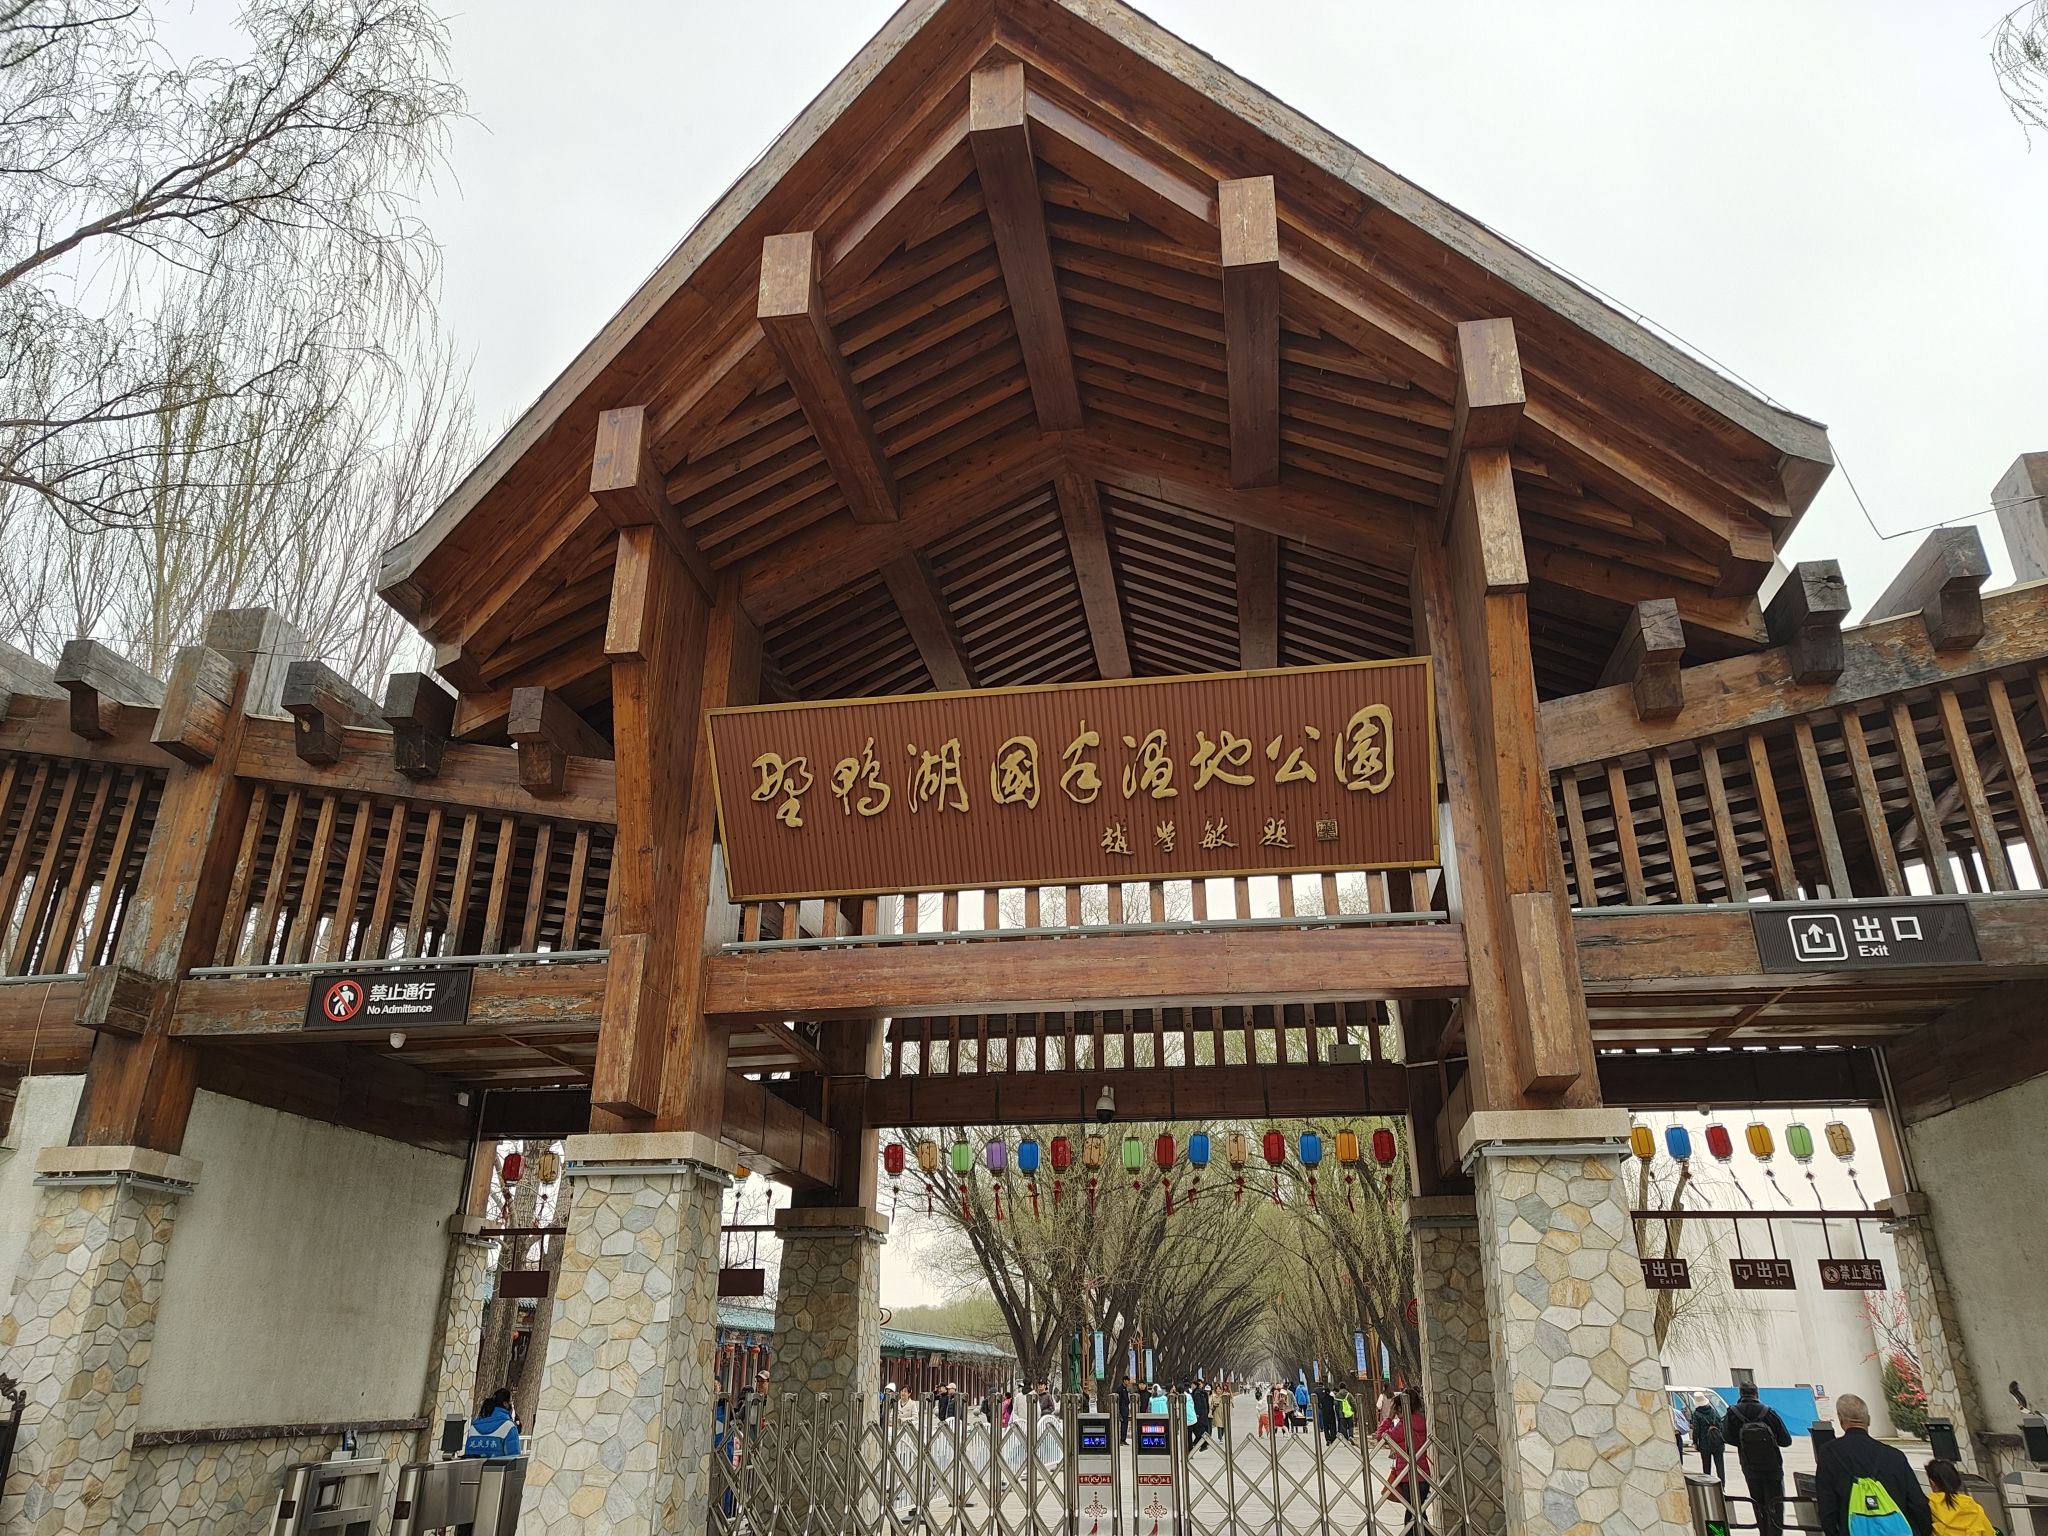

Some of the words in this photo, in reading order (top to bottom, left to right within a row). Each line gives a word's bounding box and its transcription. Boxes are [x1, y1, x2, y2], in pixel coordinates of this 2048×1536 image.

[1852, 915, 1923, 942] 出口
[1858, 945, 1890, 957] Exit
[369, 982, 436, 1002] 禁止通行
[366, 1005, 381, 1015] No
[381, 1004, 433, 1015] Admittance
[1652, 1261, 1685, 1278] 出口
[1756, 1262, 1790, 1278] 出口
[1839, 1264, 1882, 1280] 禁止通行
